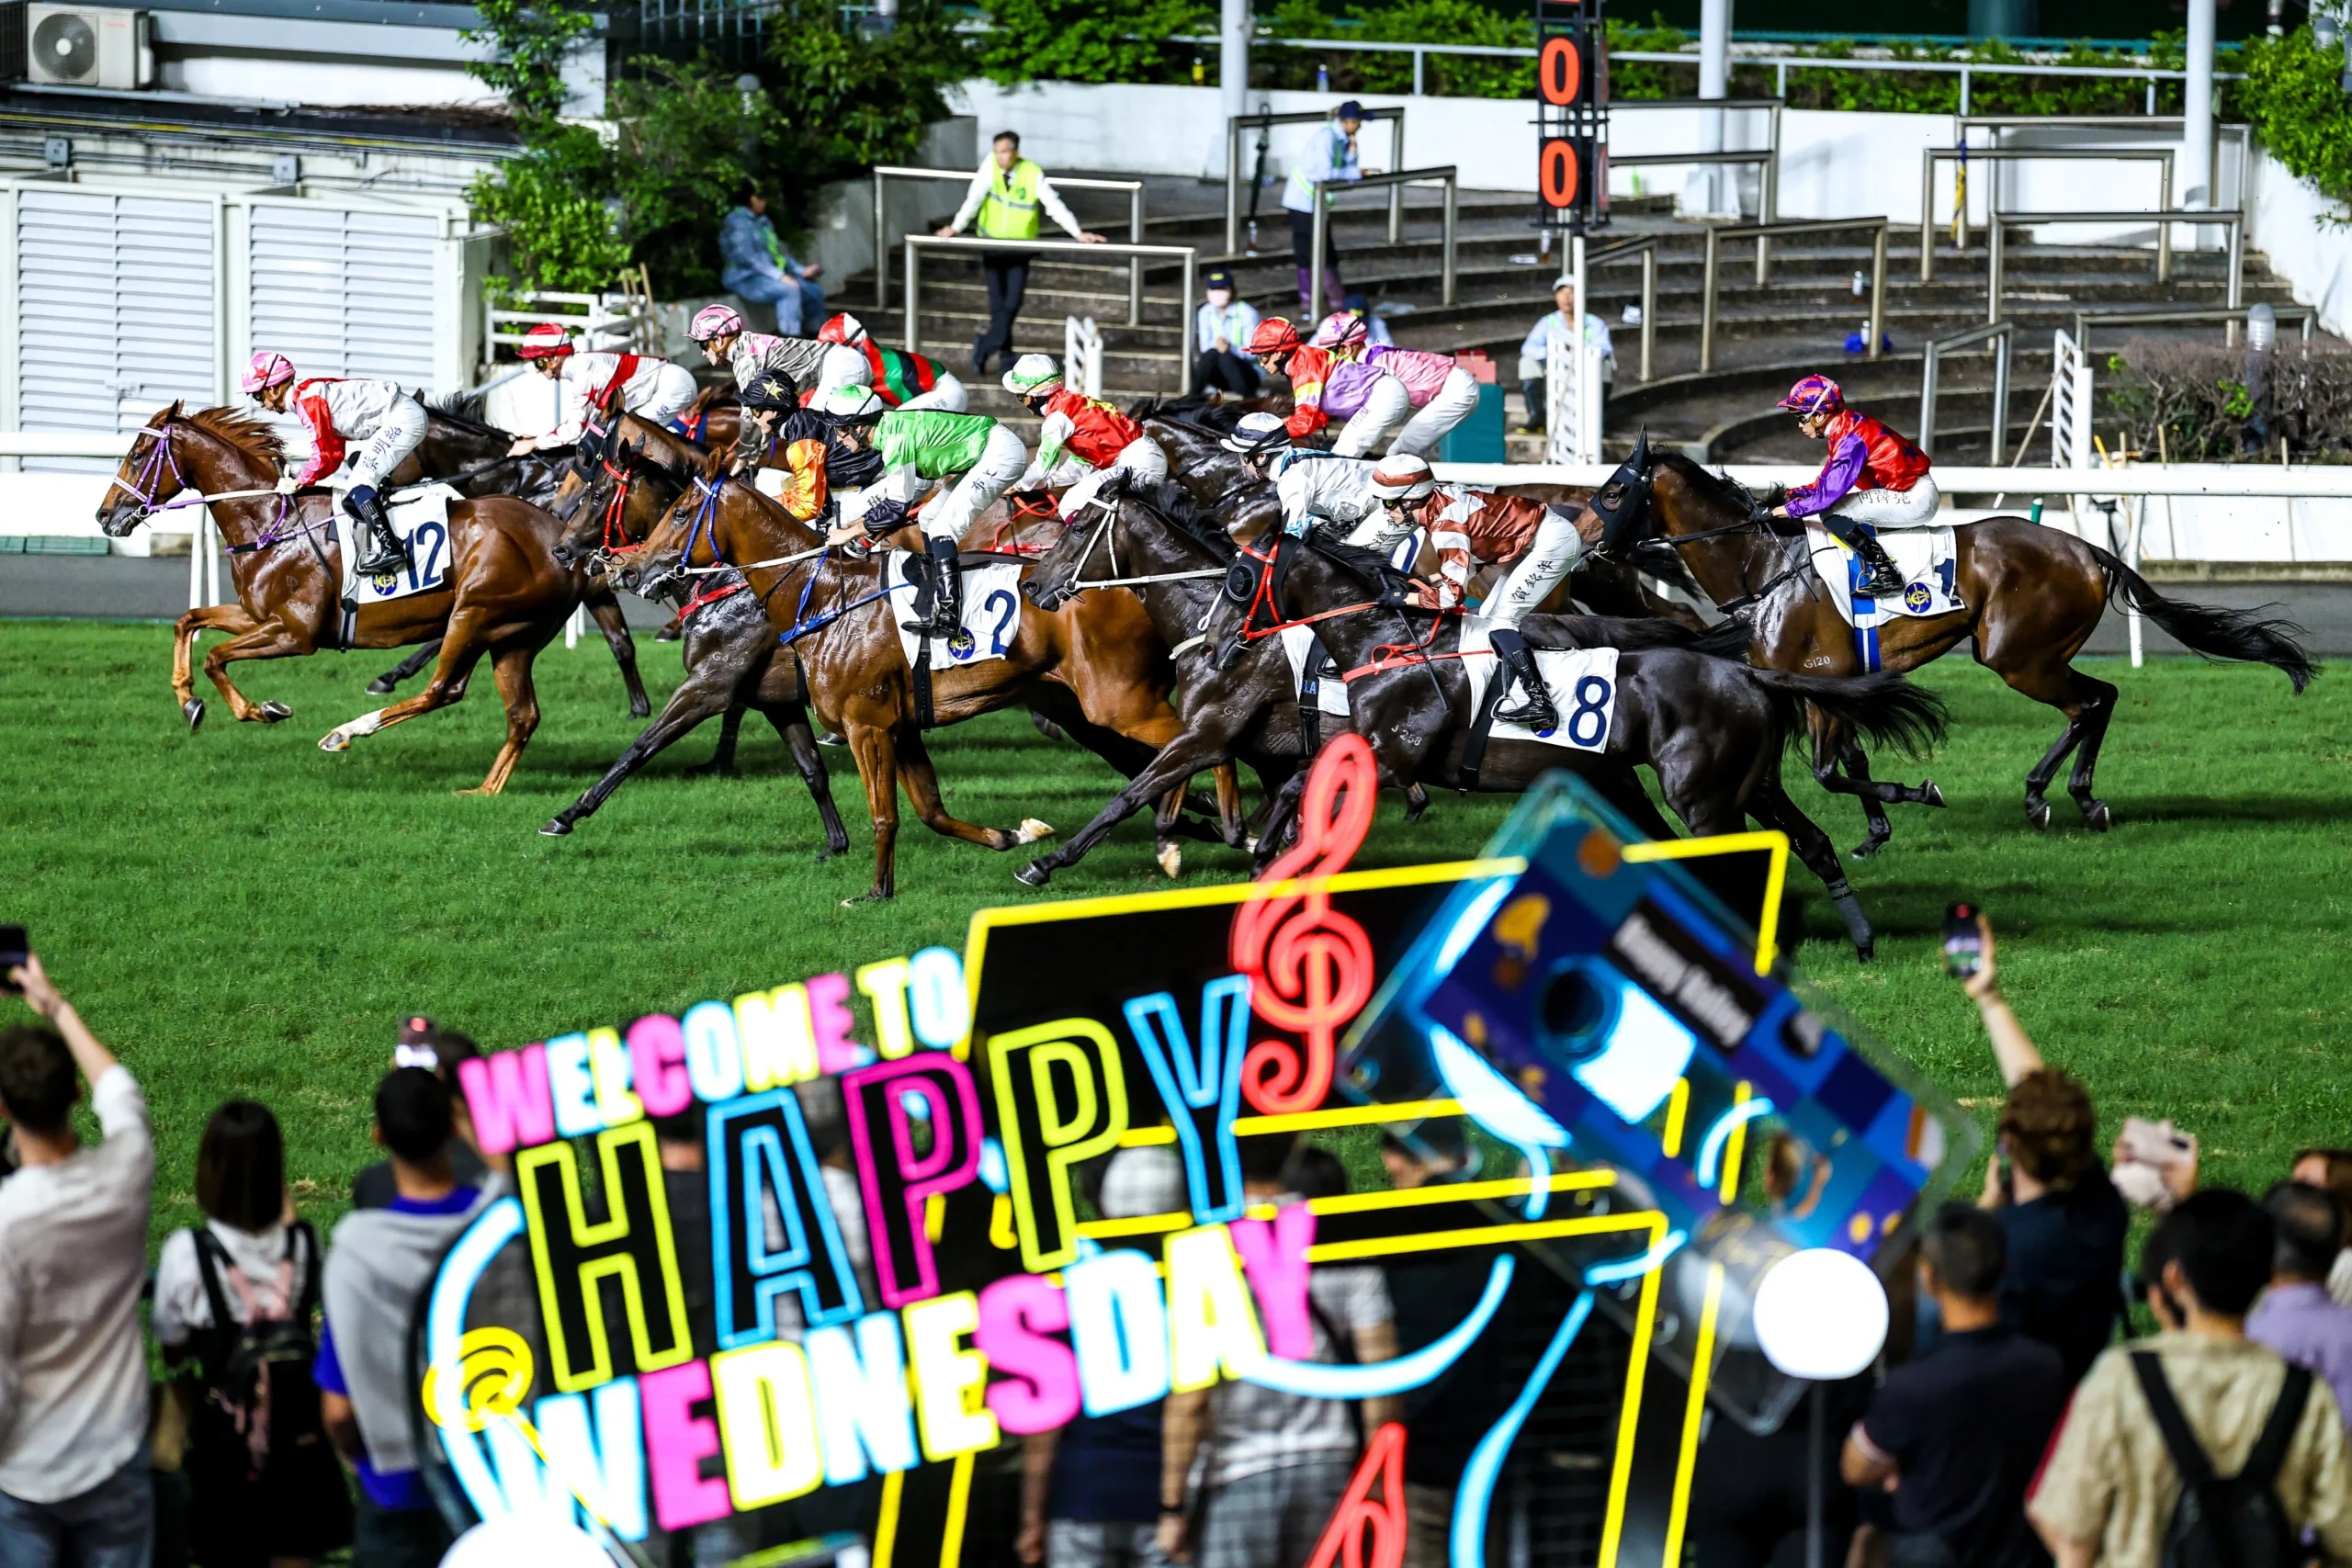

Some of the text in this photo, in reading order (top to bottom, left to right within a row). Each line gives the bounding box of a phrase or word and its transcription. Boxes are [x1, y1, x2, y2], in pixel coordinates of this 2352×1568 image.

[404, 521, 446, 591] 12
[1934, 558, 1963, 607] 1
[985, 590, 1016, 655] 2
[1568, 675, 1611, 747] 8
[458, 945, 970, 1155] WELCOME TO
[516, 974, 1252, 1393] HAPPY
[478, 1201, 1316, 1543] WEDNESDAY
